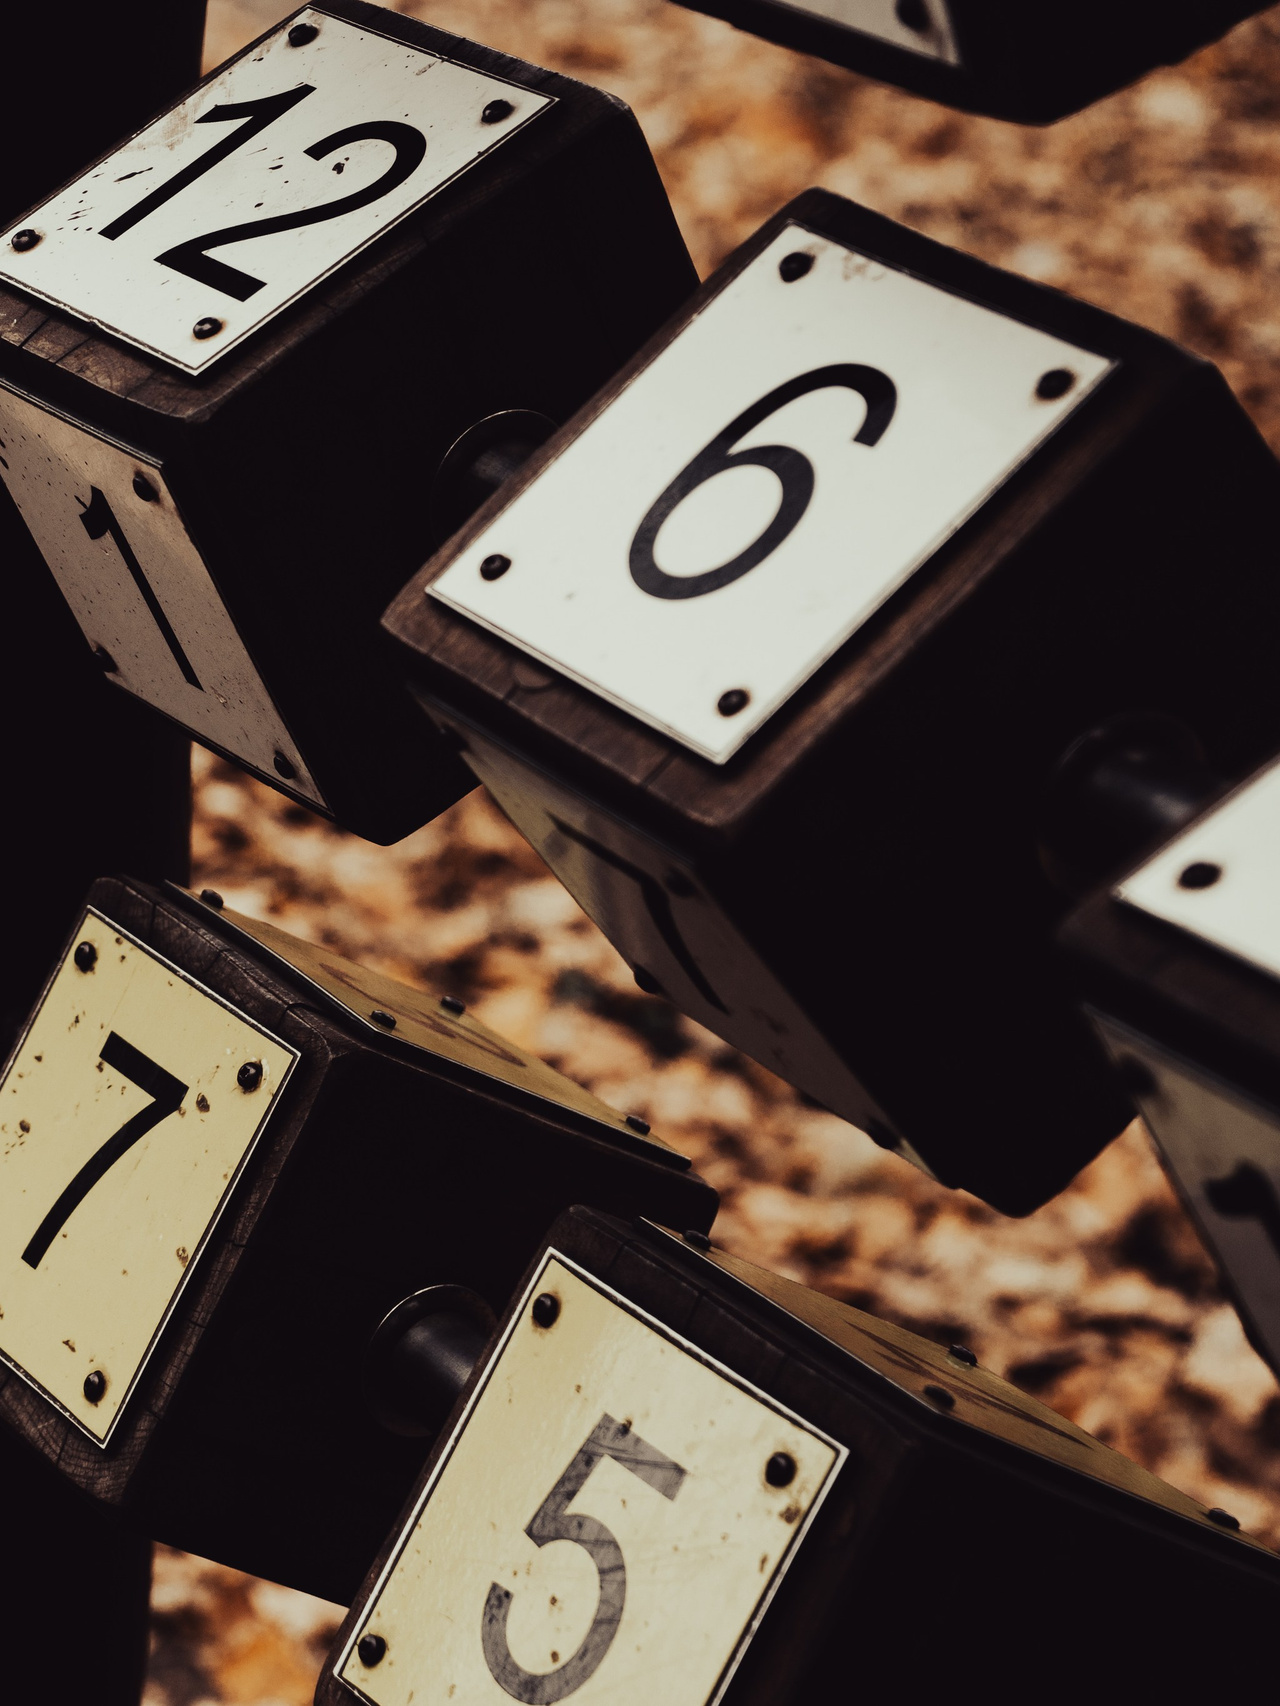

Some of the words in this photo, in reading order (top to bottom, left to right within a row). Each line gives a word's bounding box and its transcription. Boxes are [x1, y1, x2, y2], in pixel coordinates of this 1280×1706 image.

[98, 84, 427, 302] 12
[78, 484, 204, 691] 1
[628, 362, 897, 600] 6
[21, 1031, 189, 1270] 7
[482, 1413, 687, 1706] 5
